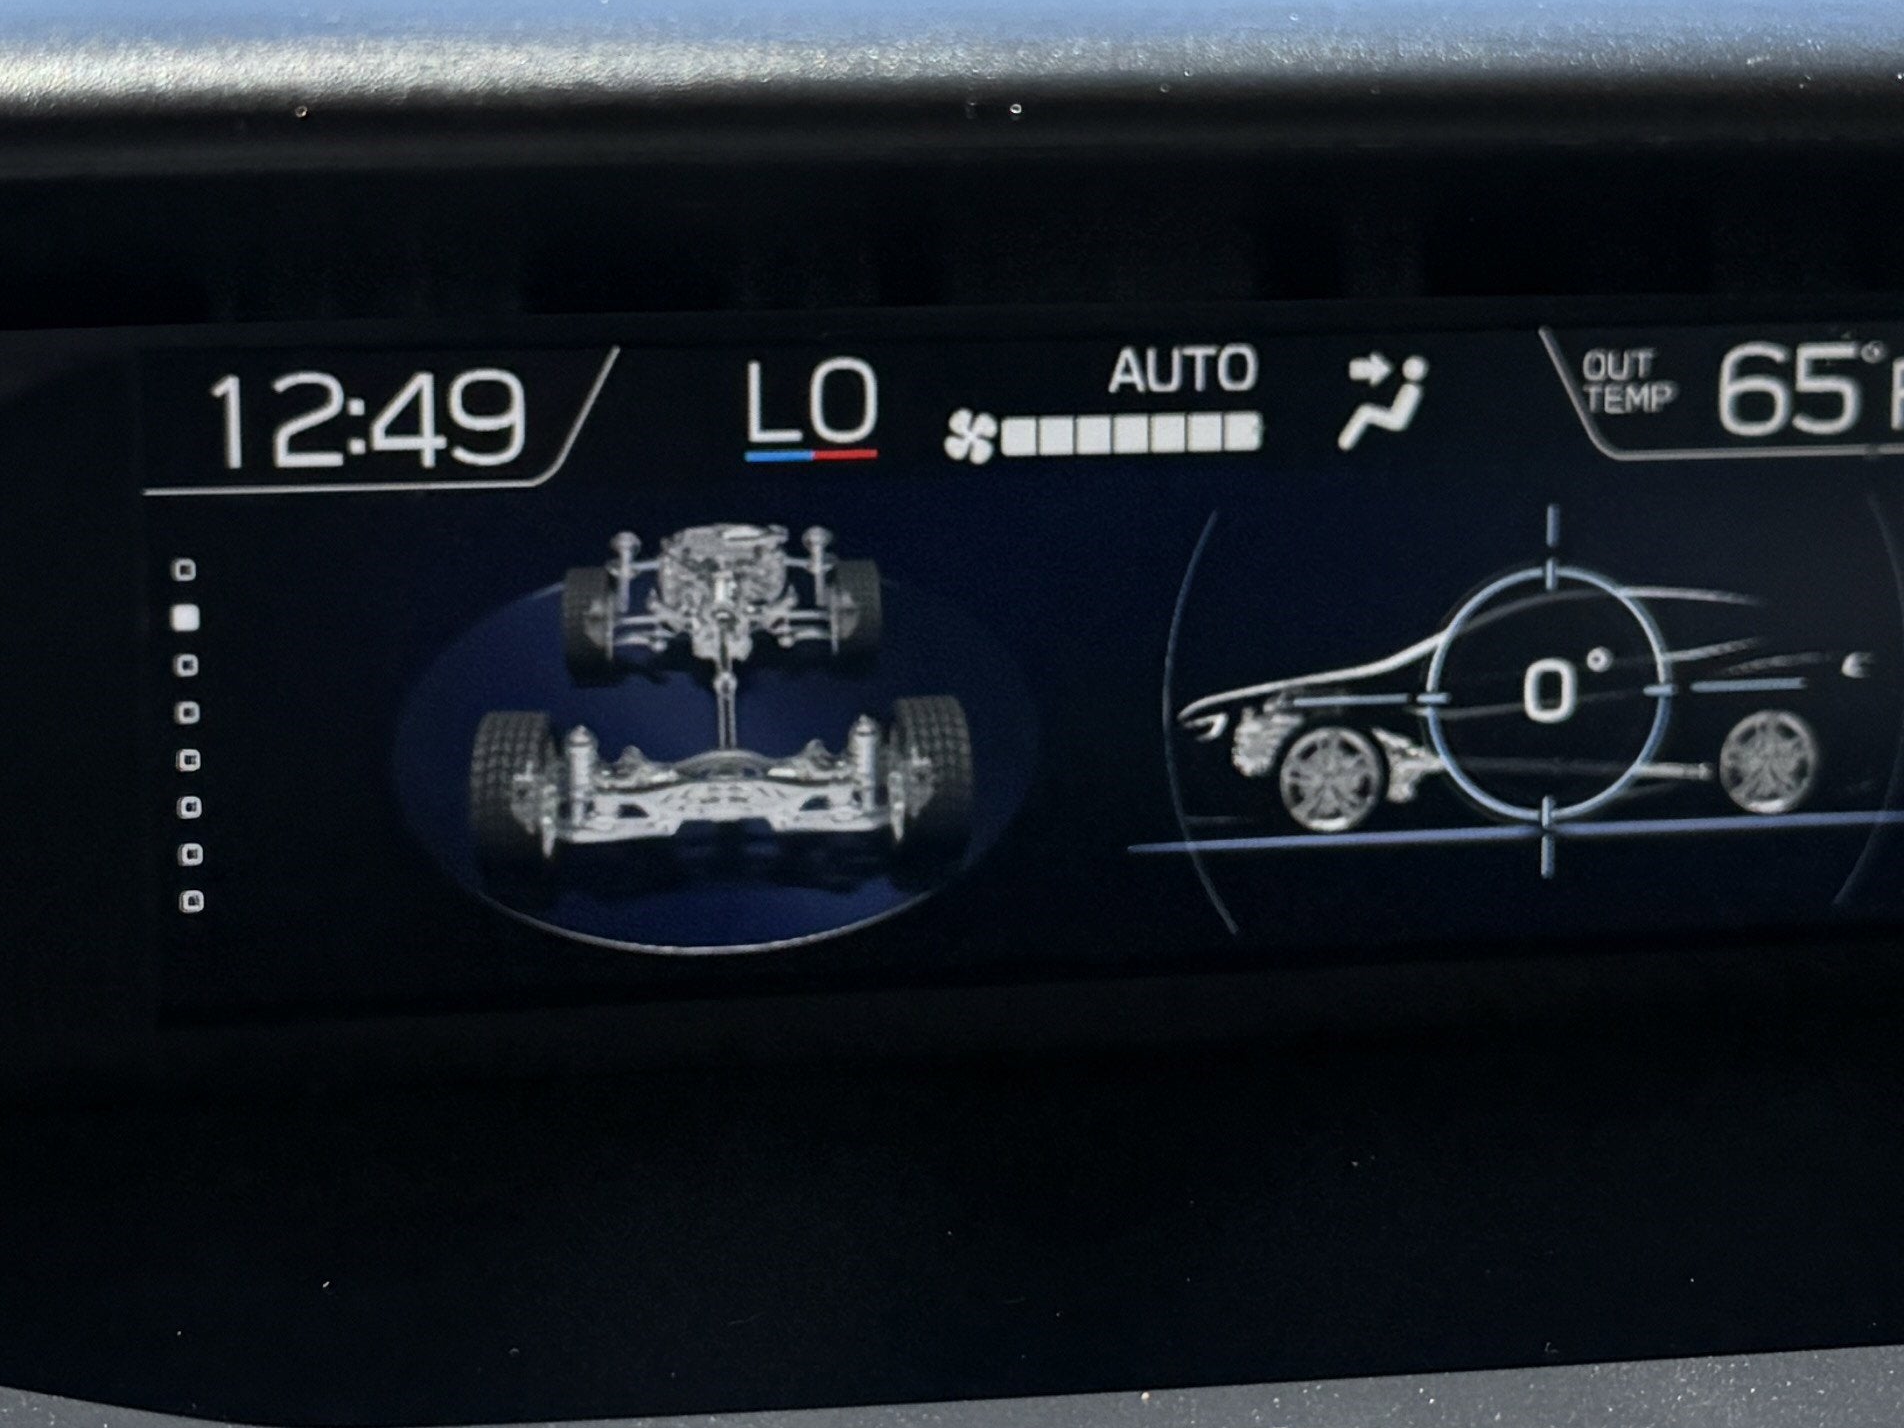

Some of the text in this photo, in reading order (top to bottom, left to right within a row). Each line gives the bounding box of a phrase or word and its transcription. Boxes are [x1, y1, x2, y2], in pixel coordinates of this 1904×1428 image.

[1107, 343, 1259, 394] AUTO
[1582, 347, 1657, 381] OUT
[211, 368, 527, 469] 12:49
[746, 356, 879, 444] LO
[1583, 381, 1679, 415] TEMP
